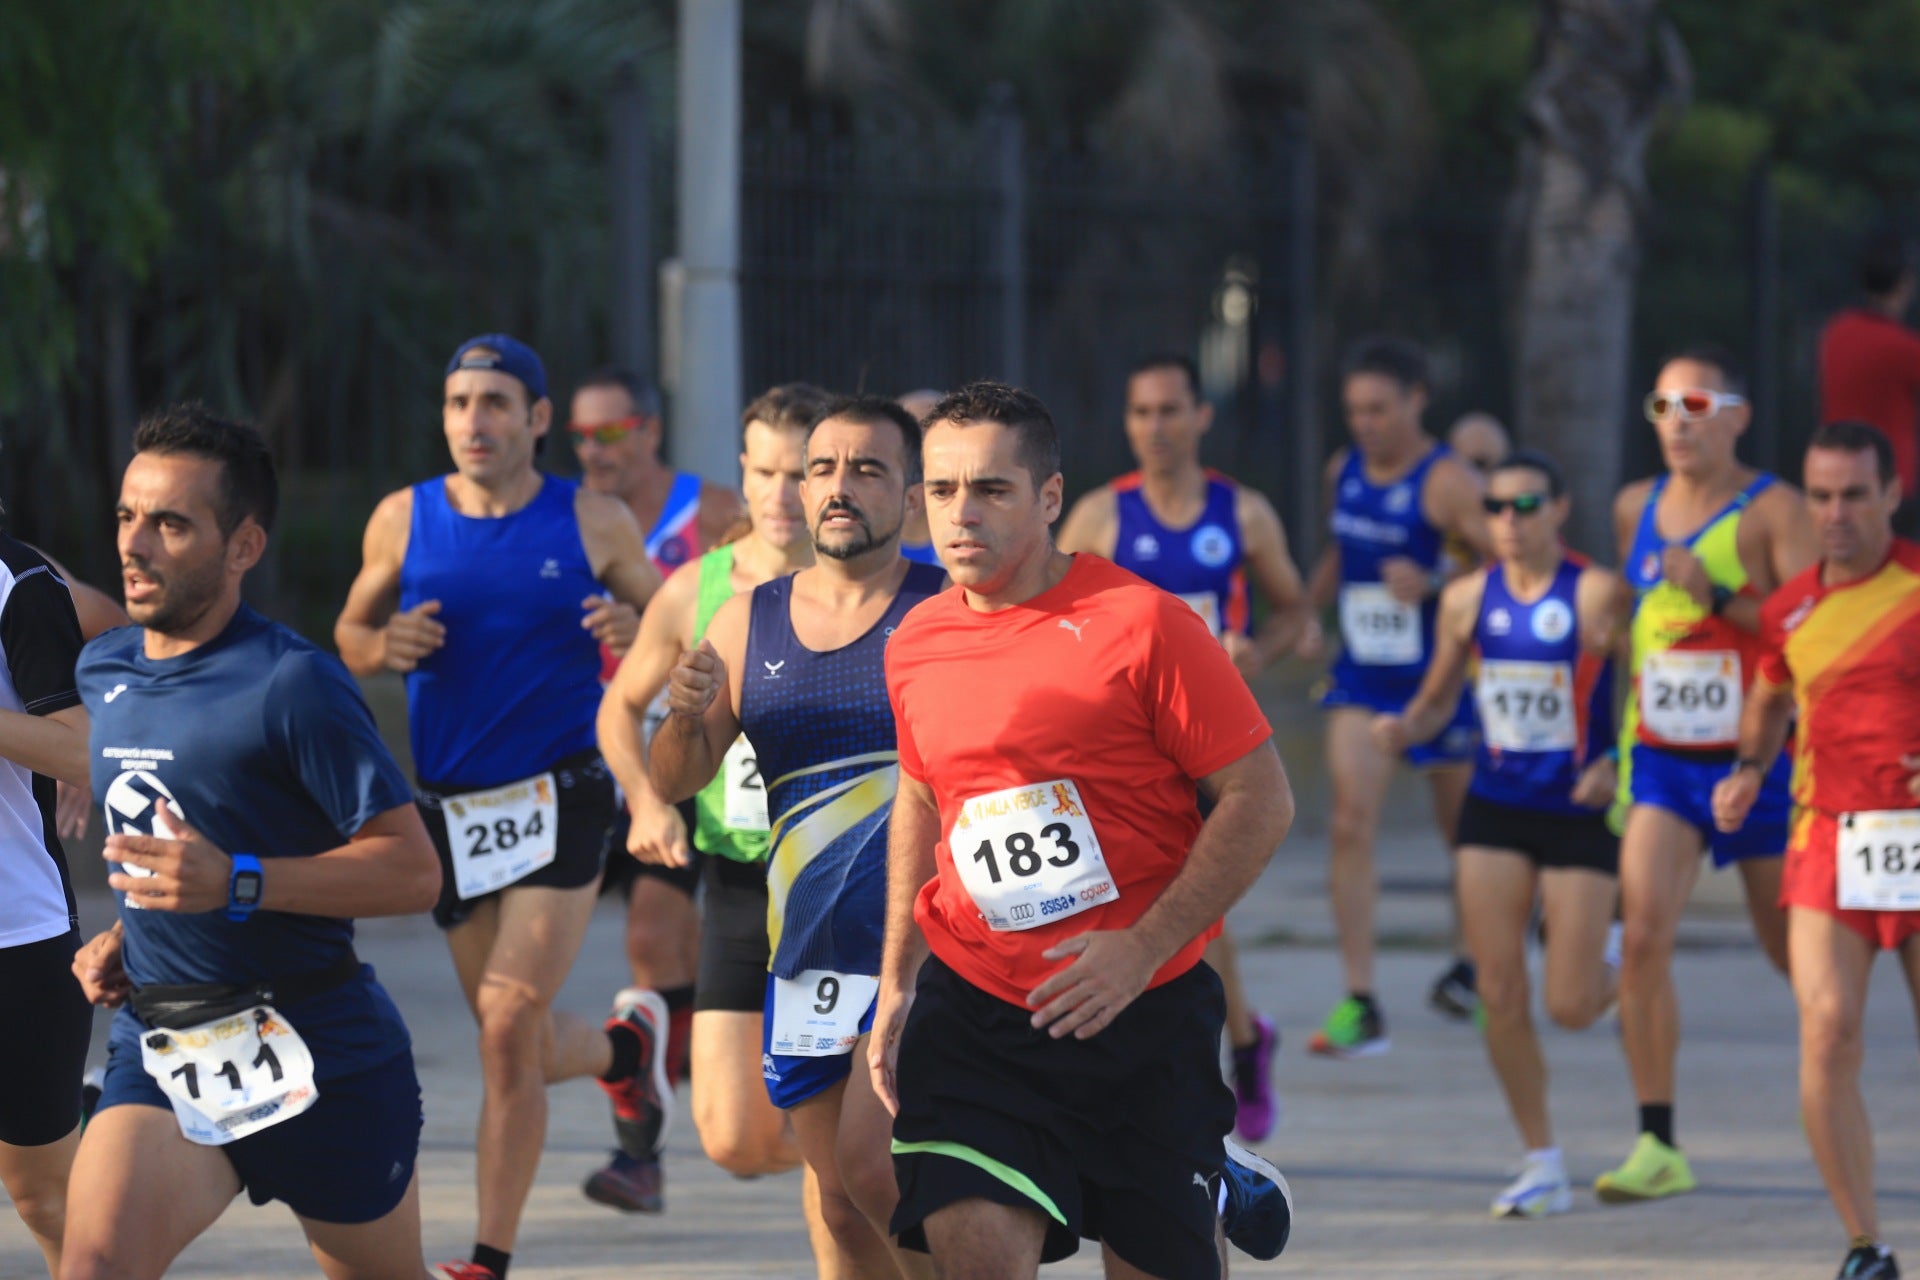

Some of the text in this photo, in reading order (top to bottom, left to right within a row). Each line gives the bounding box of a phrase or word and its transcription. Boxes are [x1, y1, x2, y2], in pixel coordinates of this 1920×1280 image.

[1494, 688, 1562, 719] 170
[1654, 681, 1728, 711] 260
[1011, 788, 1048, 811] VERDE
[465, 809, 544, 858] 284
[973, 822, 1081, 884] 183
[1040, 882, 1110, 916] asisa COVAP
[813, 976, 840, 1015] 9
[170, 1043, 284, 1100] 111
